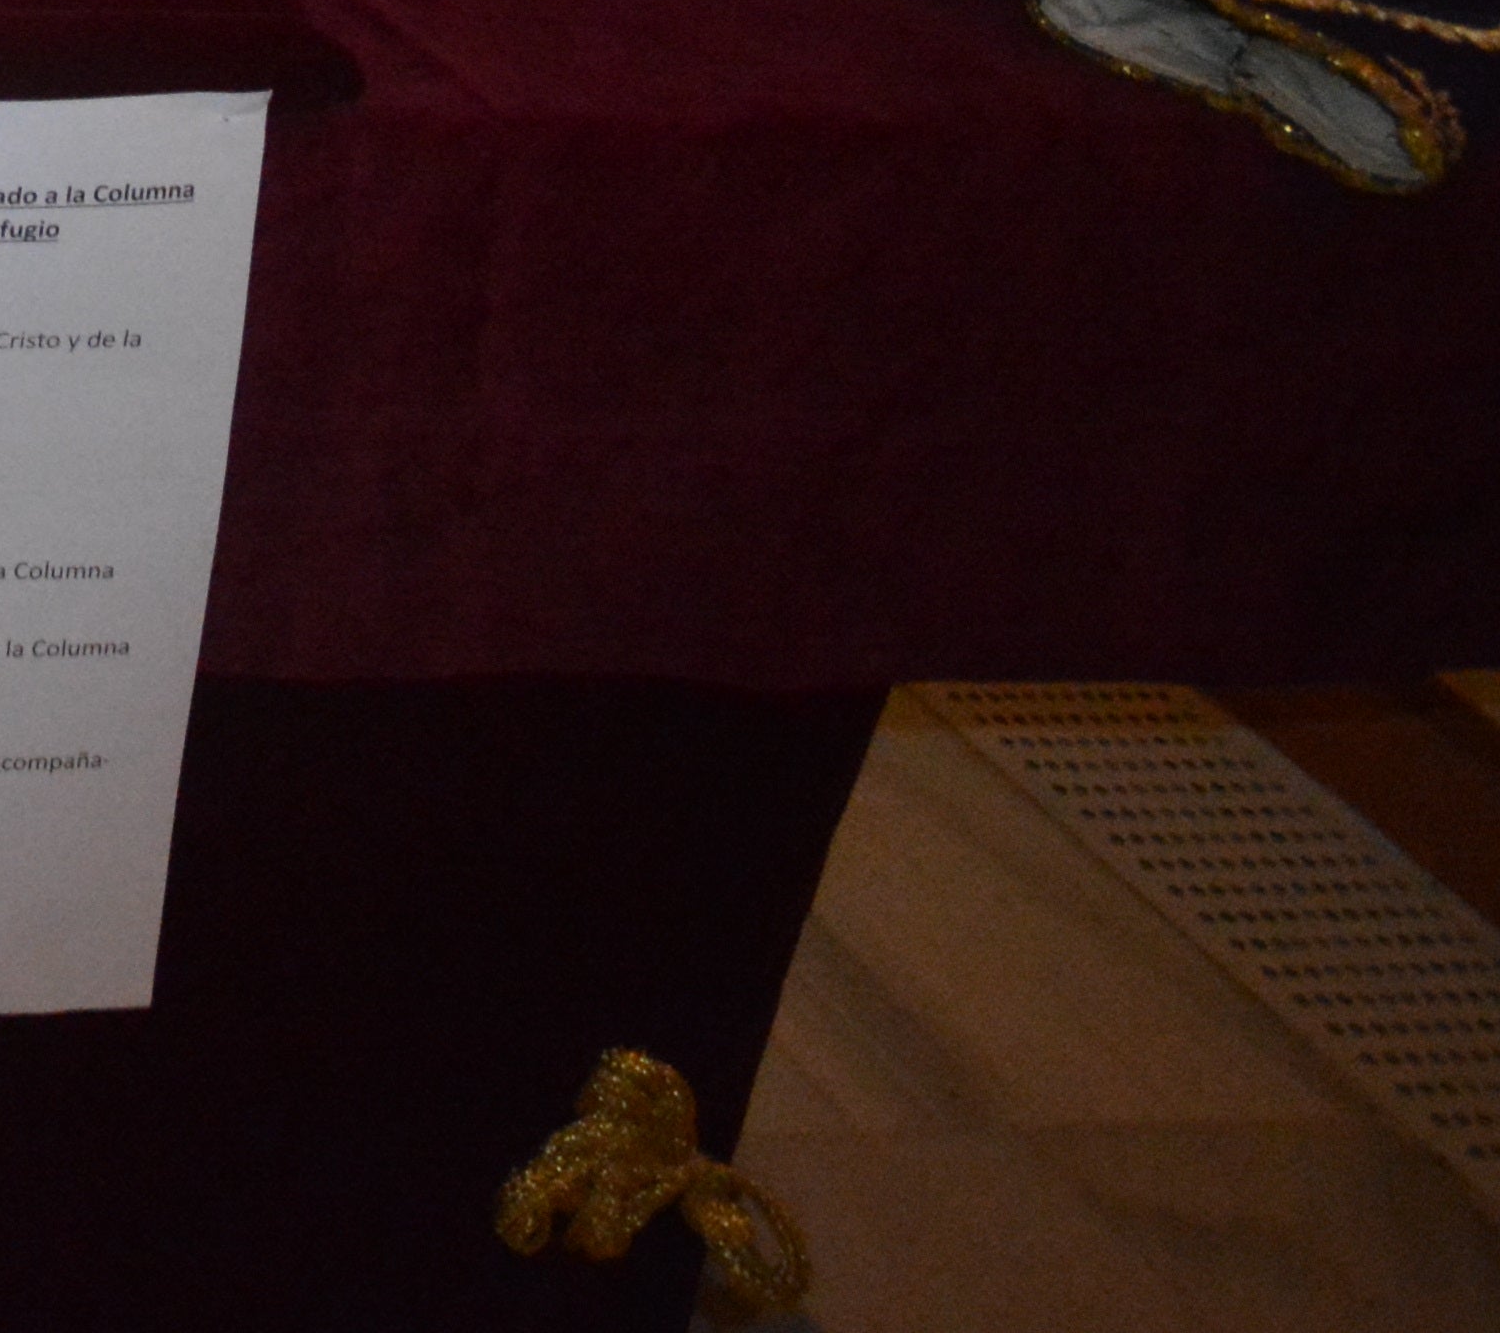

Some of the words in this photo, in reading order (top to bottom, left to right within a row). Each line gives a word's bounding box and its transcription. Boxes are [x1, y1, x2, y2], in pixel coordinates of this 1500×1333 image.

[44, 190, 58, 205] a
[66, 185, 86, 204] la
[93, 183, 195, 204] Columna
[68, 335, 81, 353] y
[86, 330, 116, 349] de
[122, 329, 142, 348] la
[13, 560, 115, 581] Columna
[5, 639, 24, 659] la
[31, 638, 131, 658] Columna
